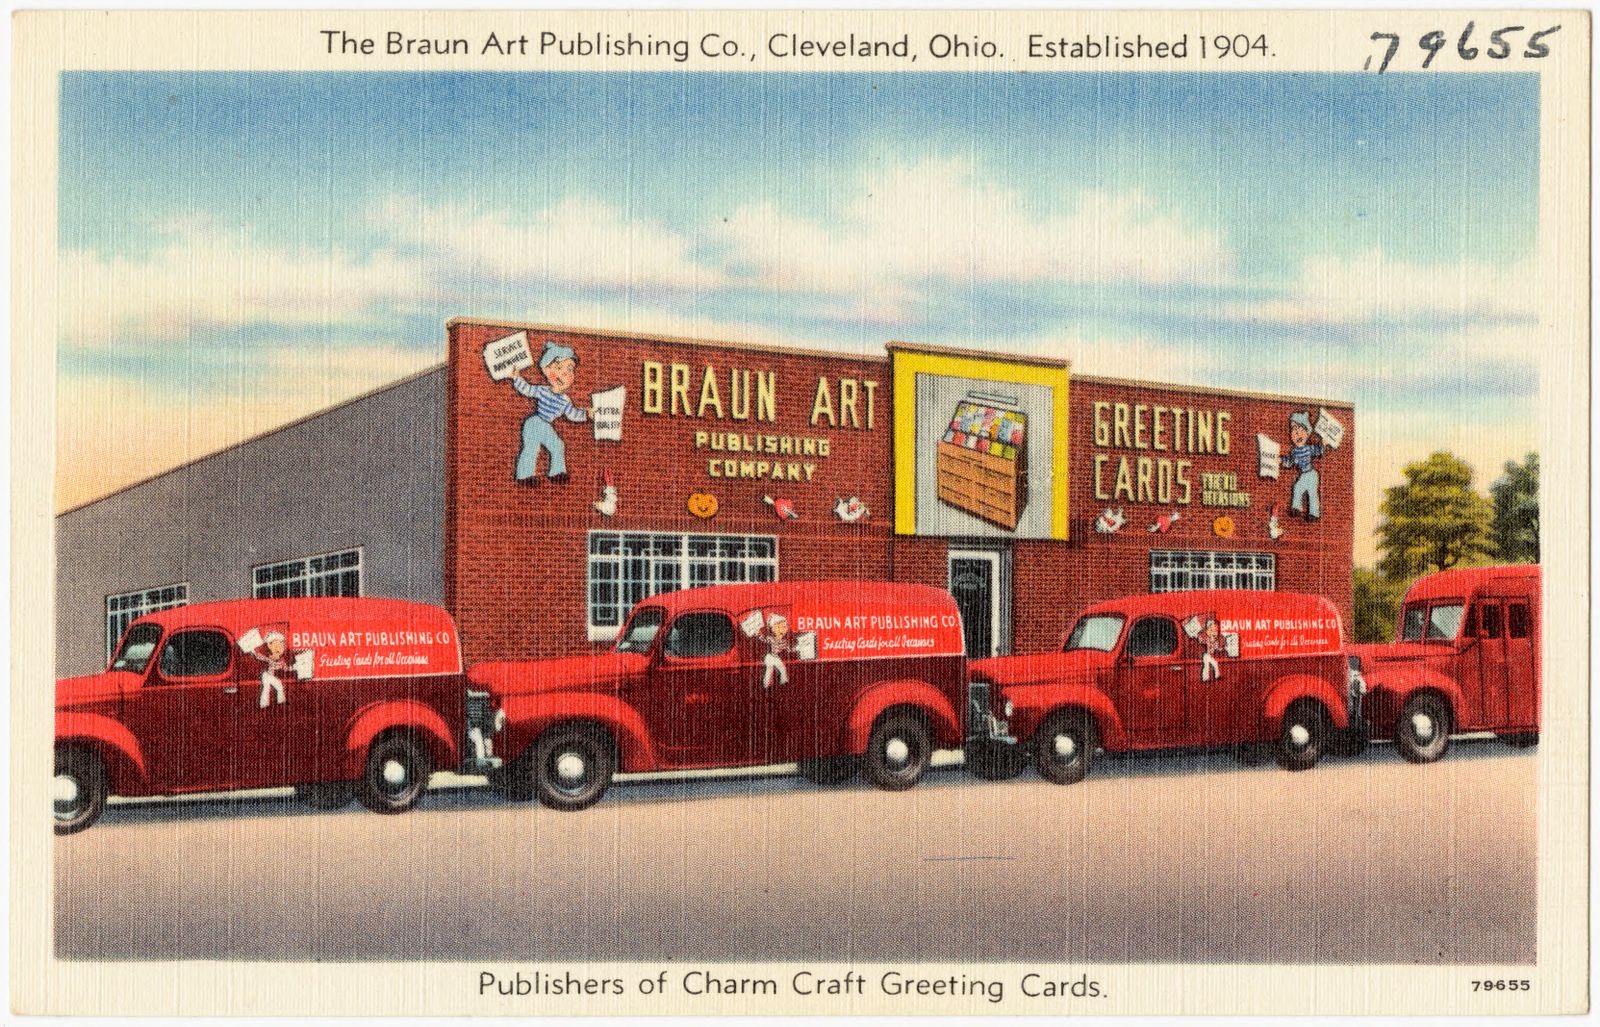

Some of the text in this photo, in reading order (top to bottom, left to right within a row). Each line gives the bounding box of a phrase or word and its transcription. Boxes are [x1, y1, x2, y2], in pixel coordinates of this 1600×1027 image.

[320, 31, 1277, 62] The Braun Art Publishing Co., Cleveland, Ohio. Established 1904.
[1370, 20, 1562, 74] 79655
[642, 361, 879, 430] BRAUN ART
[1094, 401, 1231, 455] GREETING
[695, 430, 830, 457] PUBLISHING
[709, 459, 818, 481] COMPANY
[1094, 454, 1192, 505] CARDS
[798, 616, 841, 630] BRAUN
[844, 616, 867, 629] ART
[872, 615, 938, 629] PUBLISHING
[1220, 619, 1251, 632] BRAUN
[1254, 619, 1271, 631] ART
[1273, 618, 1324, 631] PUBLISHING
[292, 632, 336, 647] BRAUN
[340, 632, 363, 647] ART
[366, 631, 433, 646] PUBLISHING
[479, 971, 1109, 1002] Publishers of Charm Craft Greeting Cards.
[1471, 979, 1531, 992] 79655
